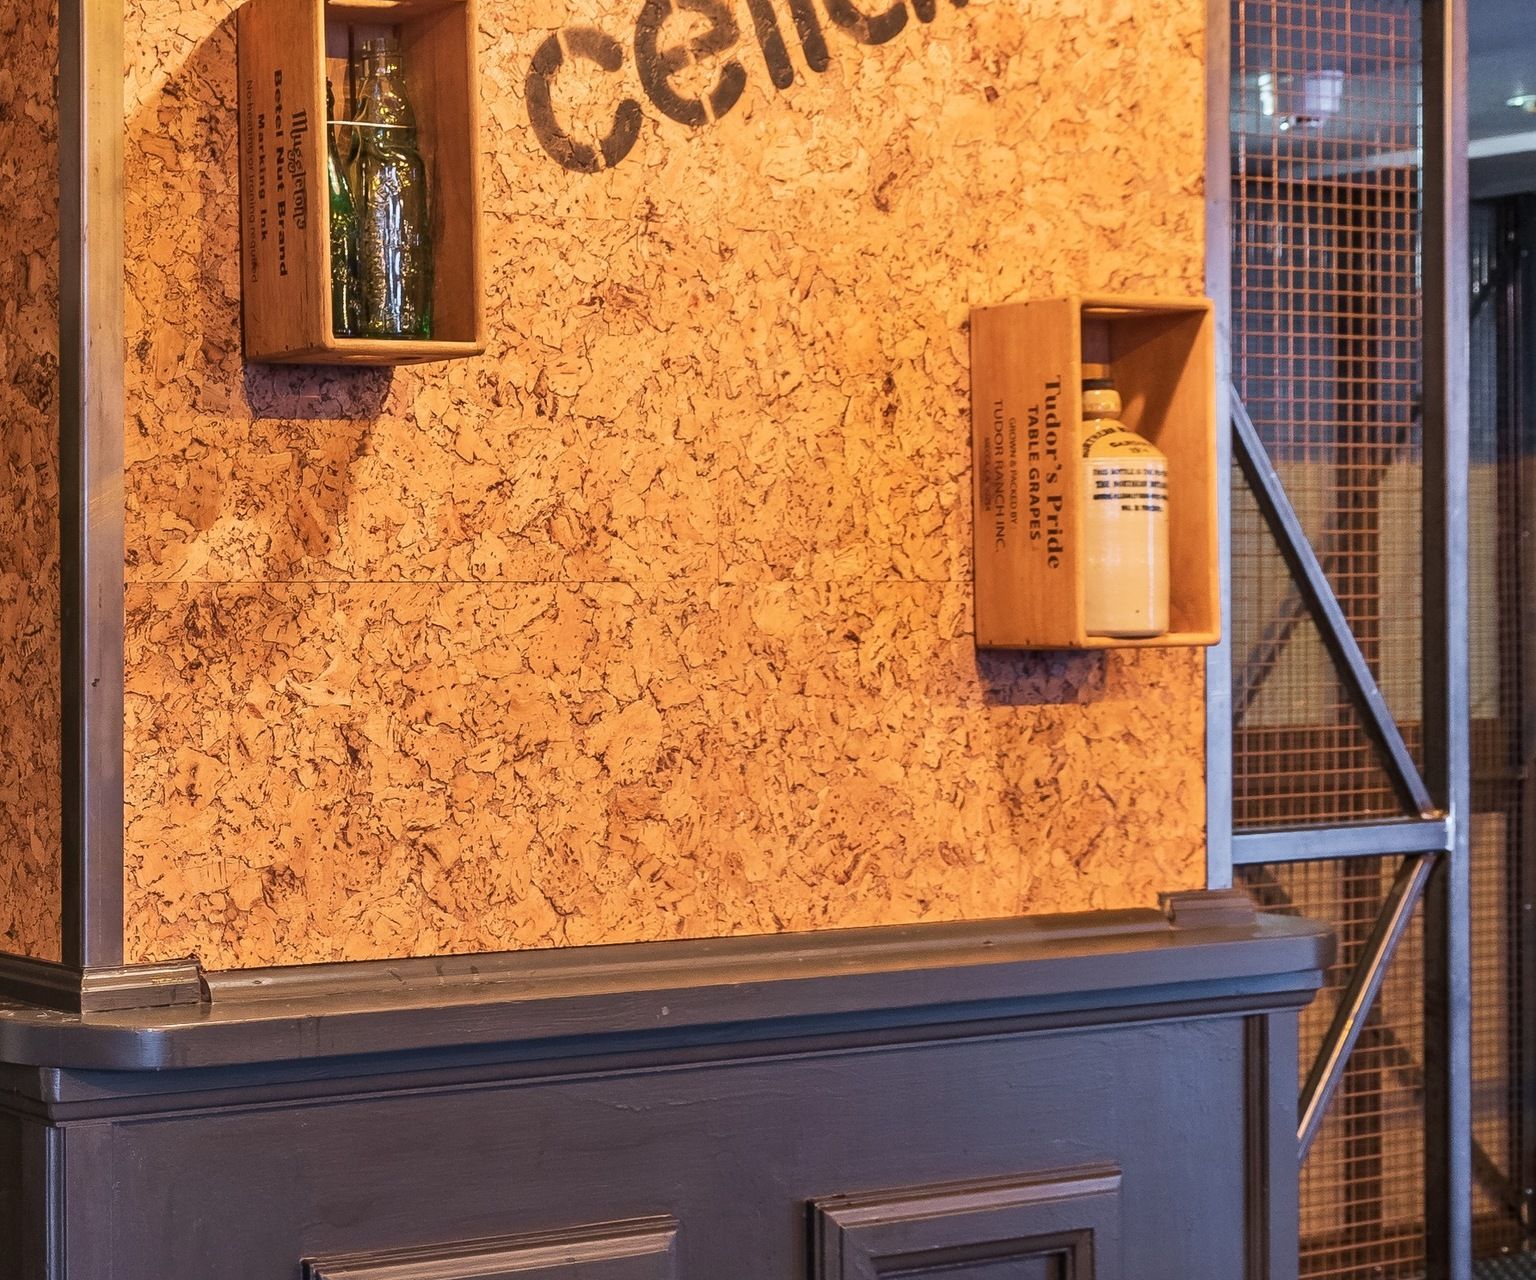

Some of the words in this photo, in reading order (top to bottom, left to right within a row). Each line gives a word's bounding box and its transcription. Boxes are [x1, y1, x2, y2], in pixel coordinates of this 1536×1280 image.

[275, 70, 284, 137] Betel
[258, 113, 267, 199] Marking
[276, 147, 286, 192] Nut
[260, 209, 268, 240] Ink
[277, 201, 289, 276] Brand
[993, 399, 1004, 455] TUDOR
[1028, 404, 1040, 461] TABLE
[994, 460, 1005, 516] RANCH
[1029, 467, 1041, 541] GRAPES
[995, 521, 1006, 553] INC.
[1047, 495, 1064, 569] Pride
